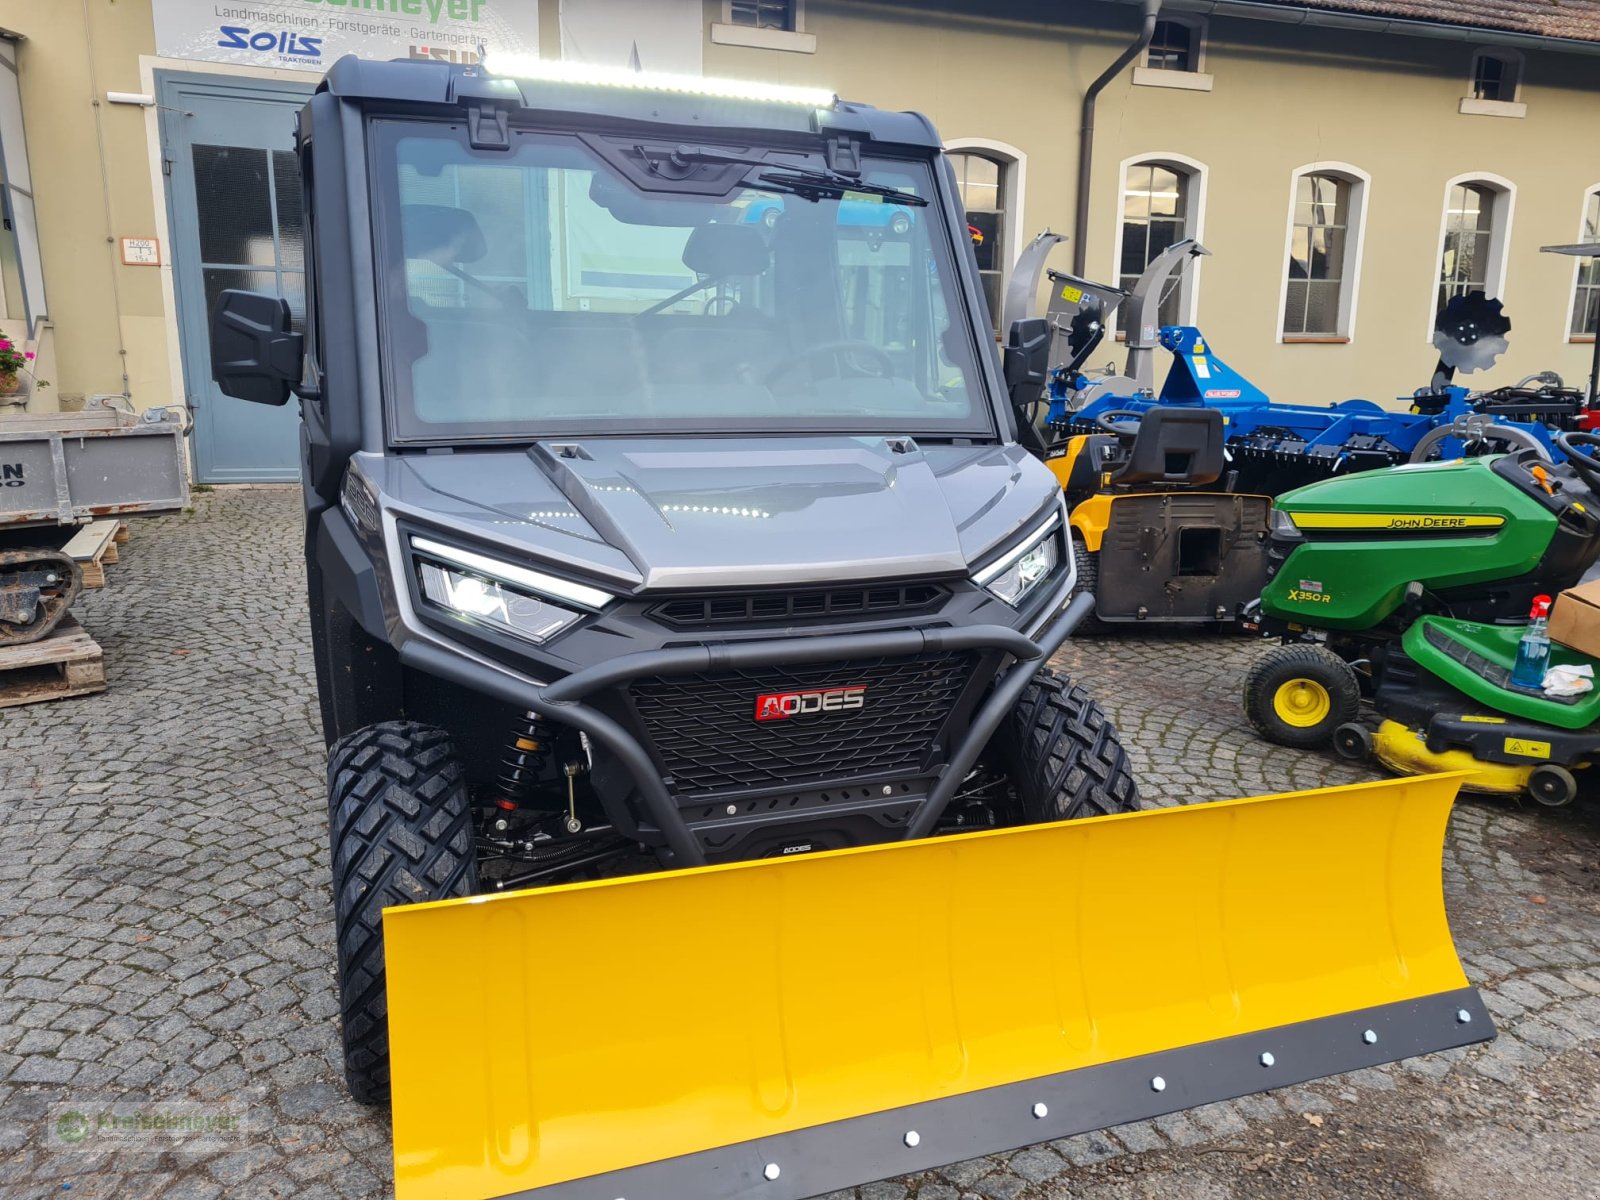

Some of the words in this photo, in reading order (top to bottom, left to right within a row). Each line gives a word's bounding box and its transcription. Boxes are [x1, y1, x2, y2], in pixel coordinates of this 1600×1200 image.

[214, 5, 319, 27] Landmaschinen
[329, 18, 401, 37] Forstgeräte
[410, 27, 488, 46] Gartengeräte
[279, 55, 322, 65] TRAKTOREN
[1388, 518, 1420, 527] JOHN
[1423, 517, 1466, 527] DEERE
[760, 688, 865, 717] AODES
